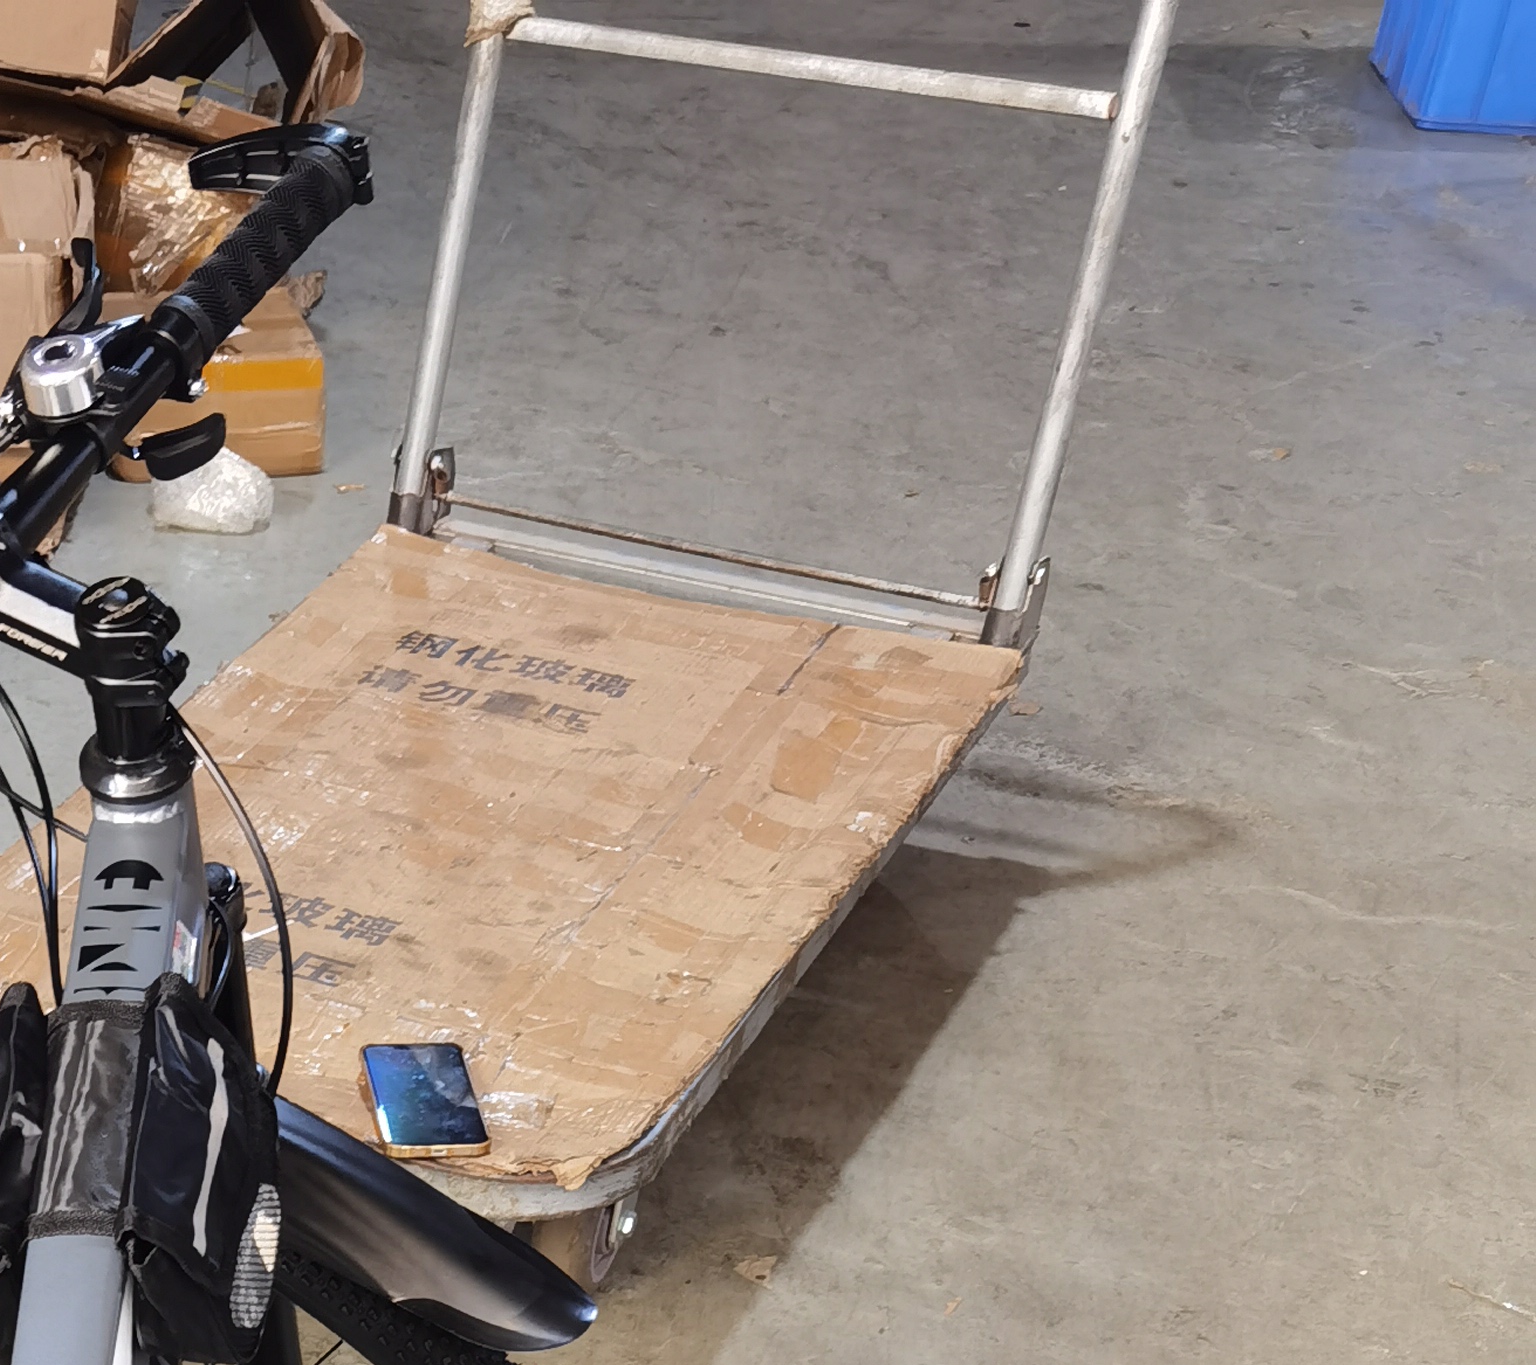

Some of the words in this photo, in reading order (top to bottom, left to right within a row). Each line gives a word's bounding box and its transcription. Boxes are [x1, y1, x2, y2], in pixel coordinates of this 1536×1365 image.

[357, 664, 602, 735] 请勿重压
[395, 630, 637, 699] 钢化玻璃
